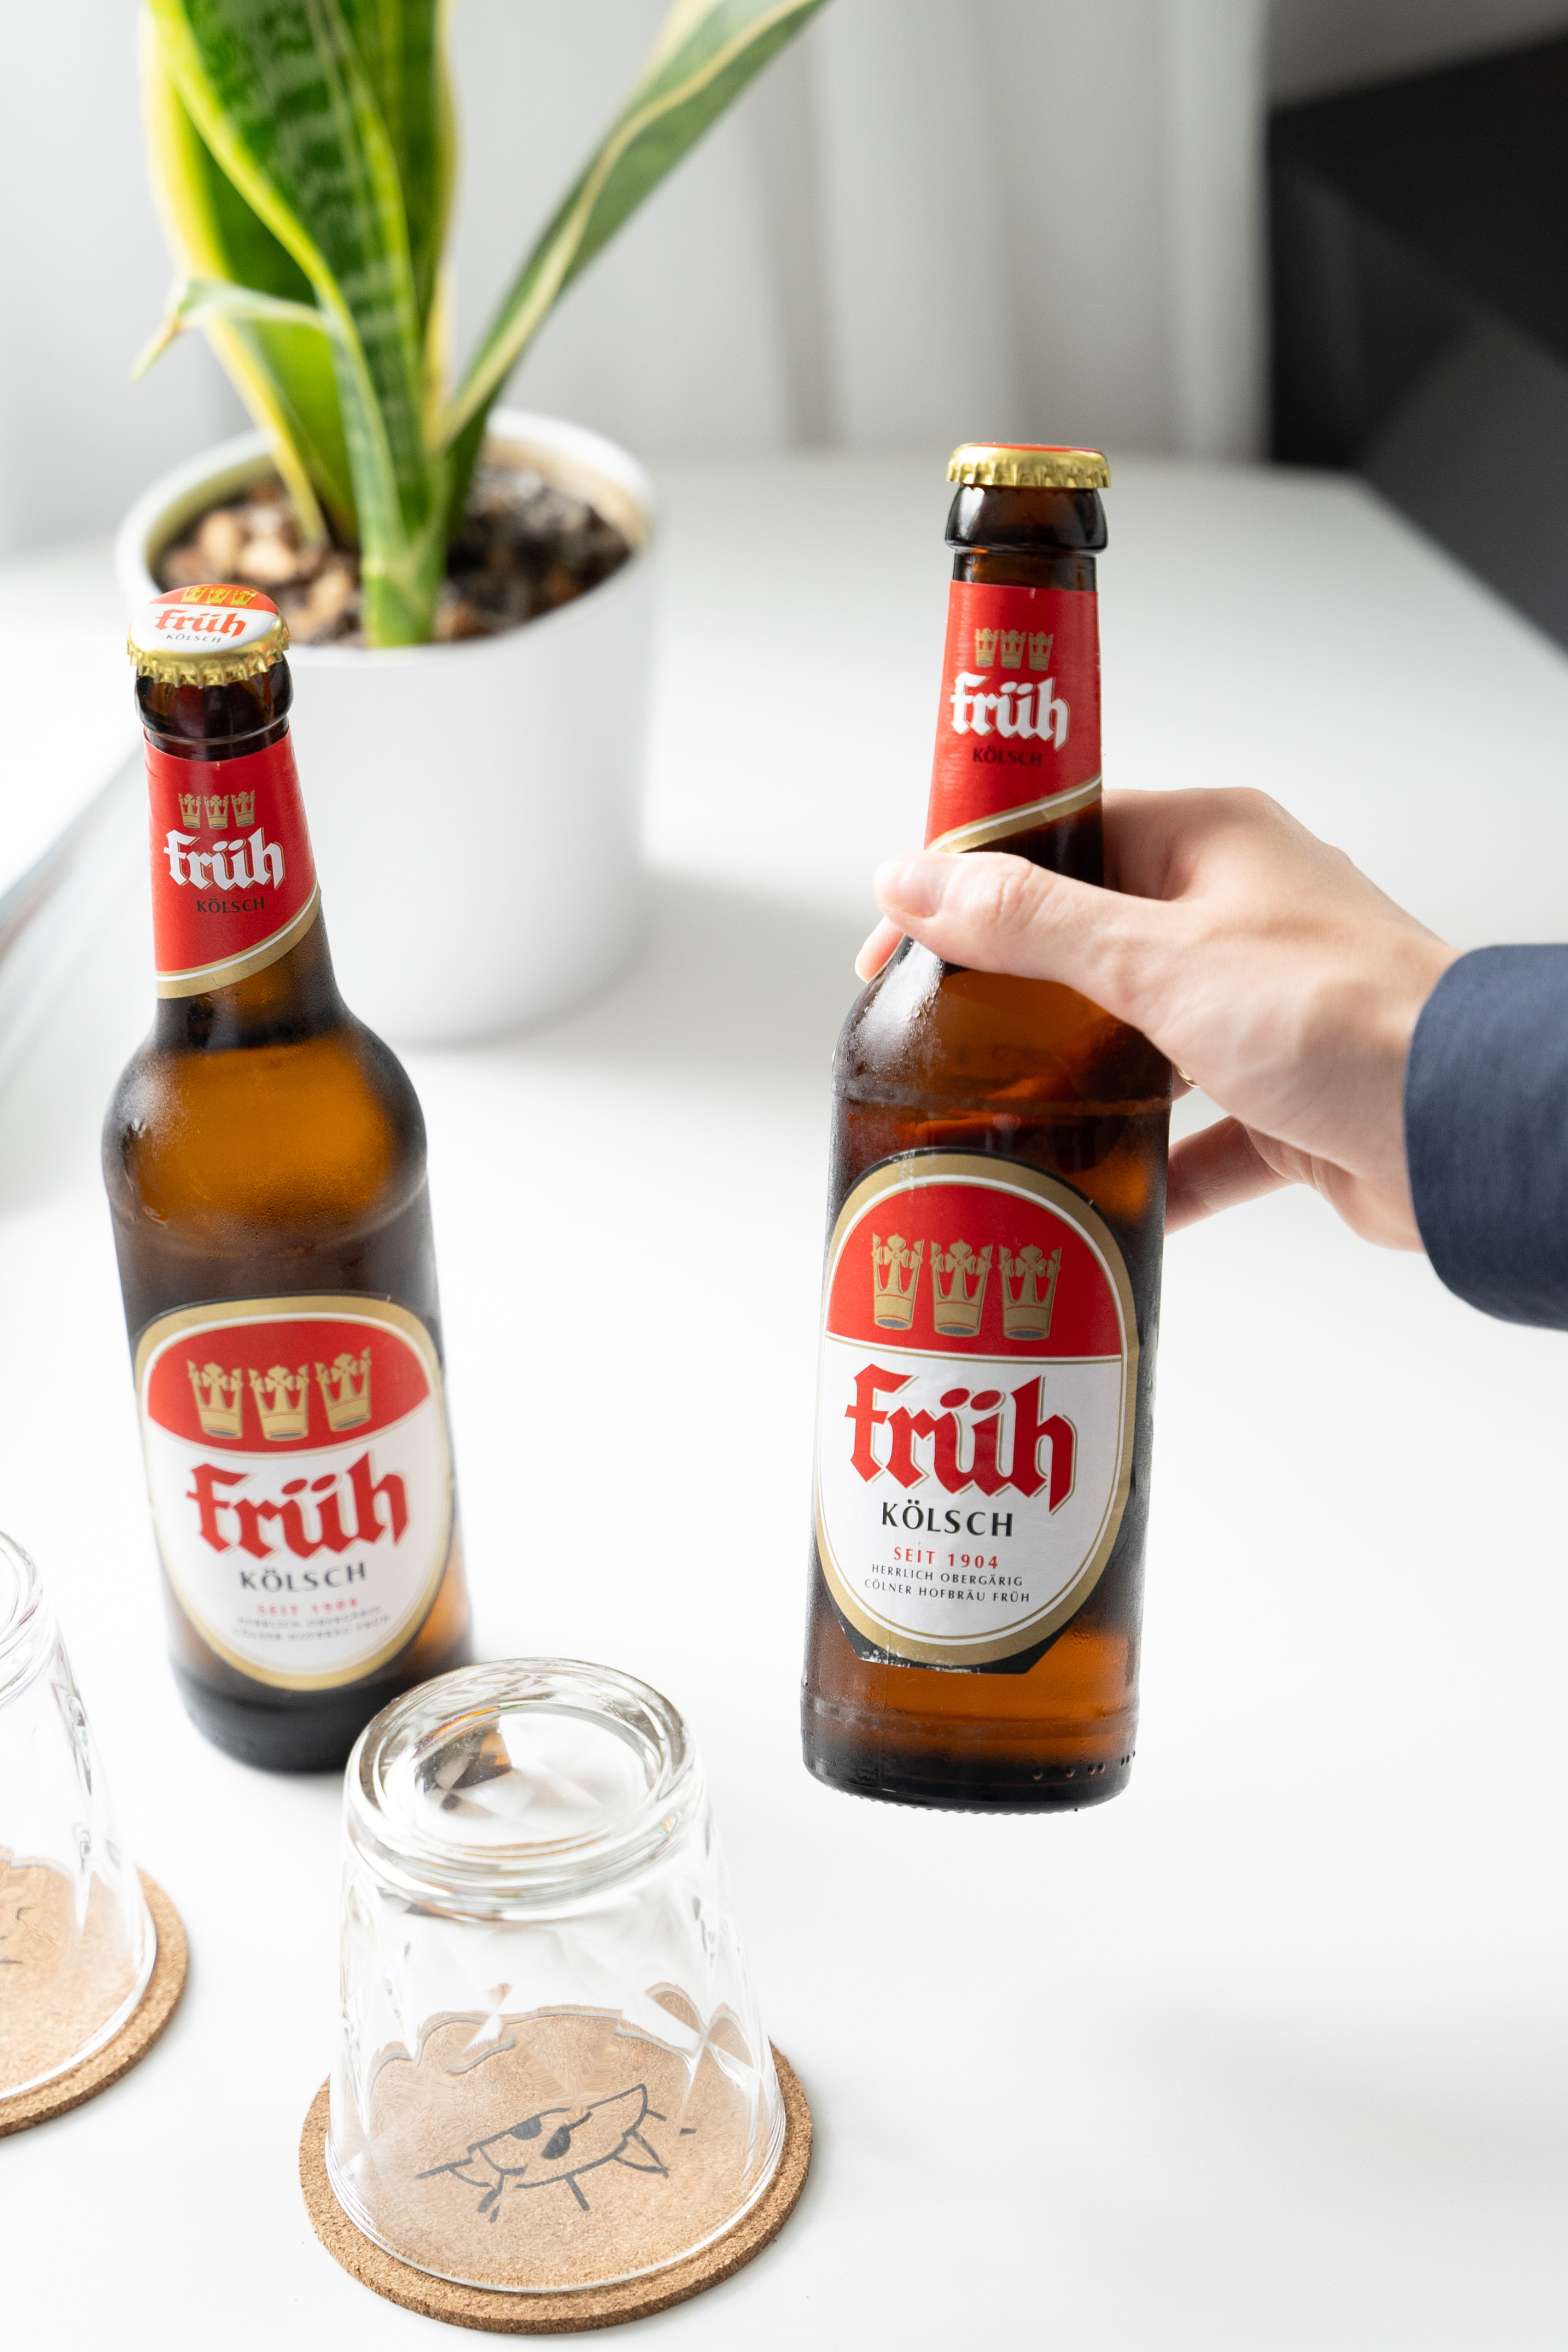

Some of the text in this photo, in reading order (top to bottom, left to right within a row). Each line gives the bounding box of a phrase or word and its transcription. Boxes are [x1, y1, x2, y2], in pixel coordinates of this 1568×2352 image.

[166, 633, 222, 643] KÖLSCH
[973, 745, 1044, 766] KÖLSCH
[196, 895, 265, 914] KÖLSCH
[882, 1498, 1013, 1538] KÖLSCH
[893, 1546, 998, 1569] SEIT 1904
[239, 1561, 366, 1592] KÖLSCH
[871, 1563, 1023, 1586] HERRLICH OBERGÄRIG
[864, 1578, 1030, 1603] CÖLNER HOFBRÄU FRÜH
